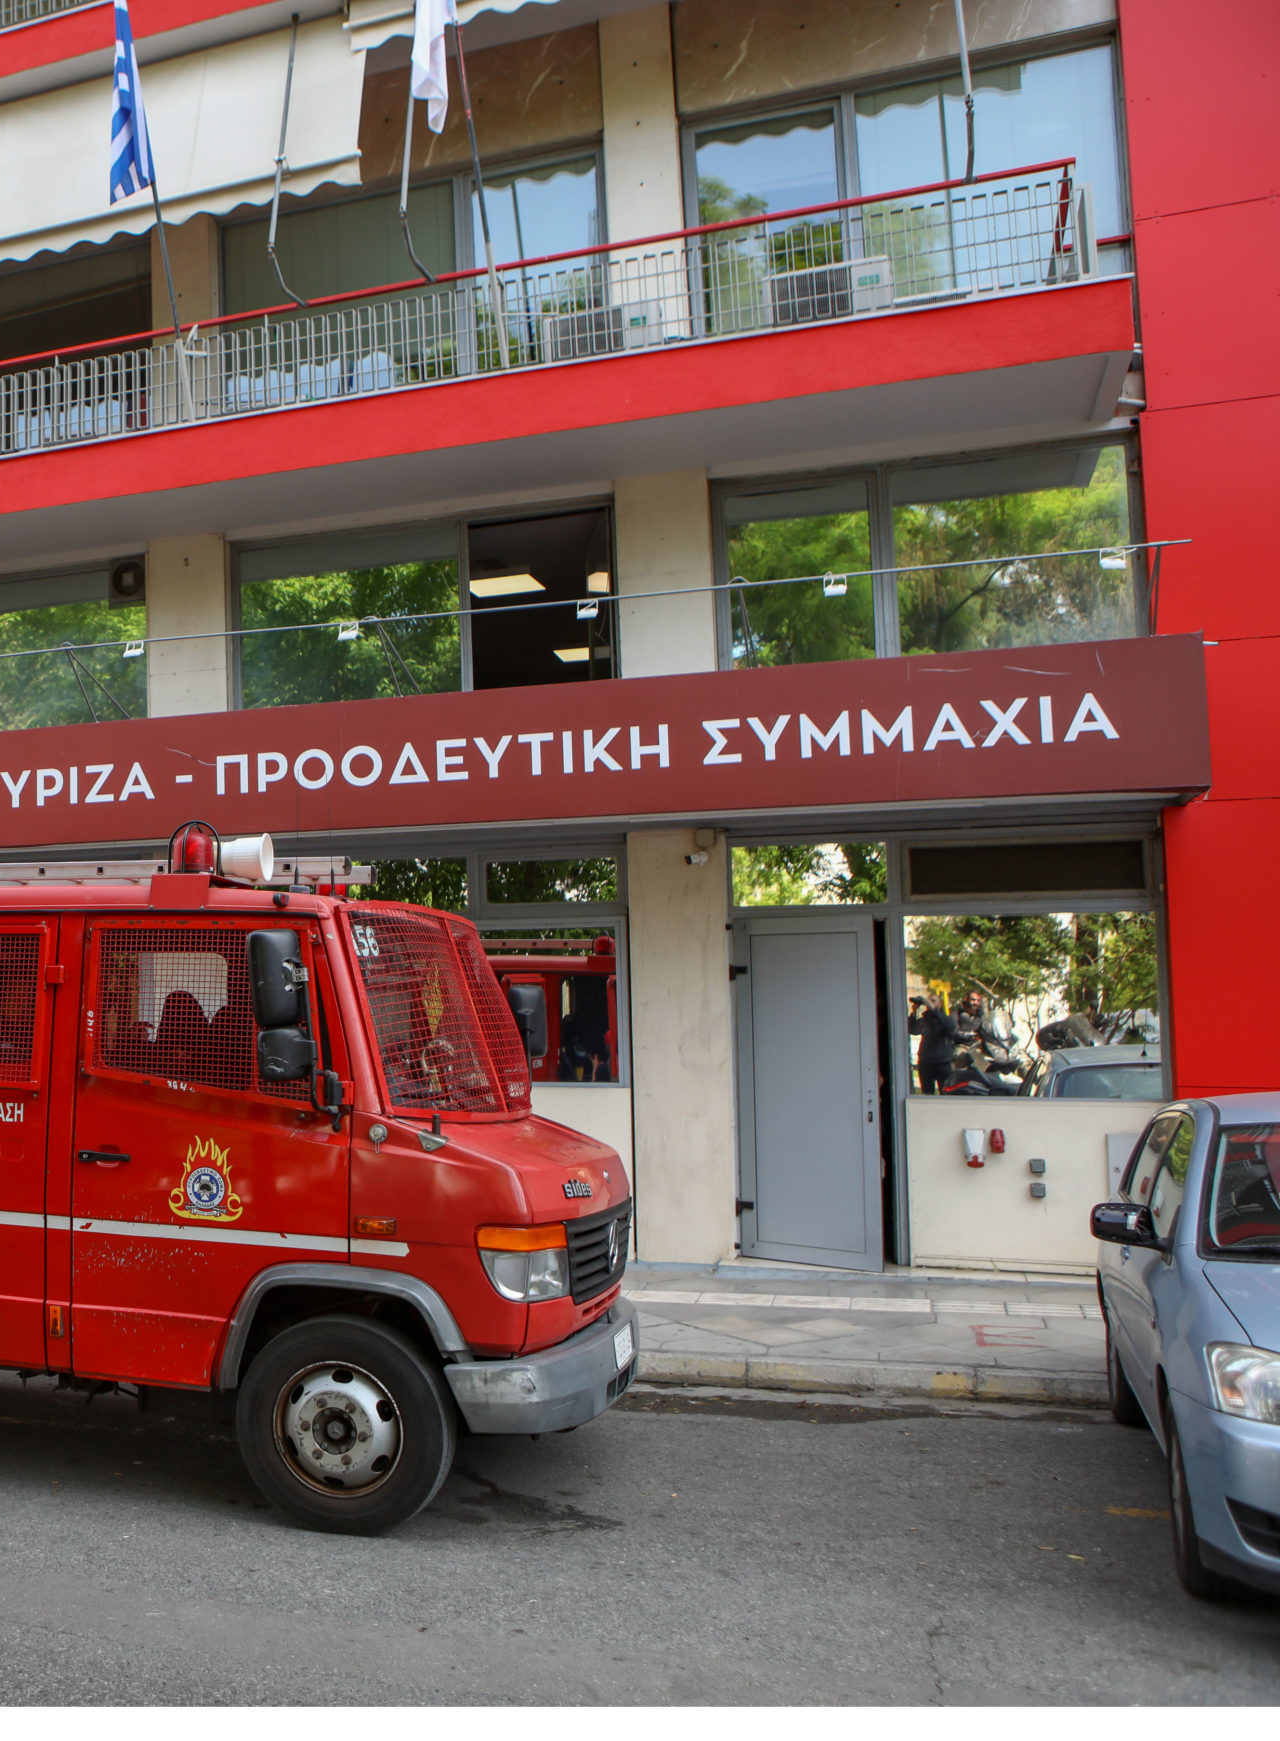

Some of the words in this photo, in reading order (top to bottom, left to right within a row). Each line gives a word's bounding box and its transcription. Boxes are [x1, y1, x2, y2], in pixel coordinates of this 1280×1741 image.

[176, 774, 192, 784] -
[217, 724, 669, 796] ΠΡΟΟΔΕΥΤΙΚΗ
[703, 693, 1120, 765] ΣΥΜΜΑΧΙΑ
[564, 1179, 592, 1198] sides
